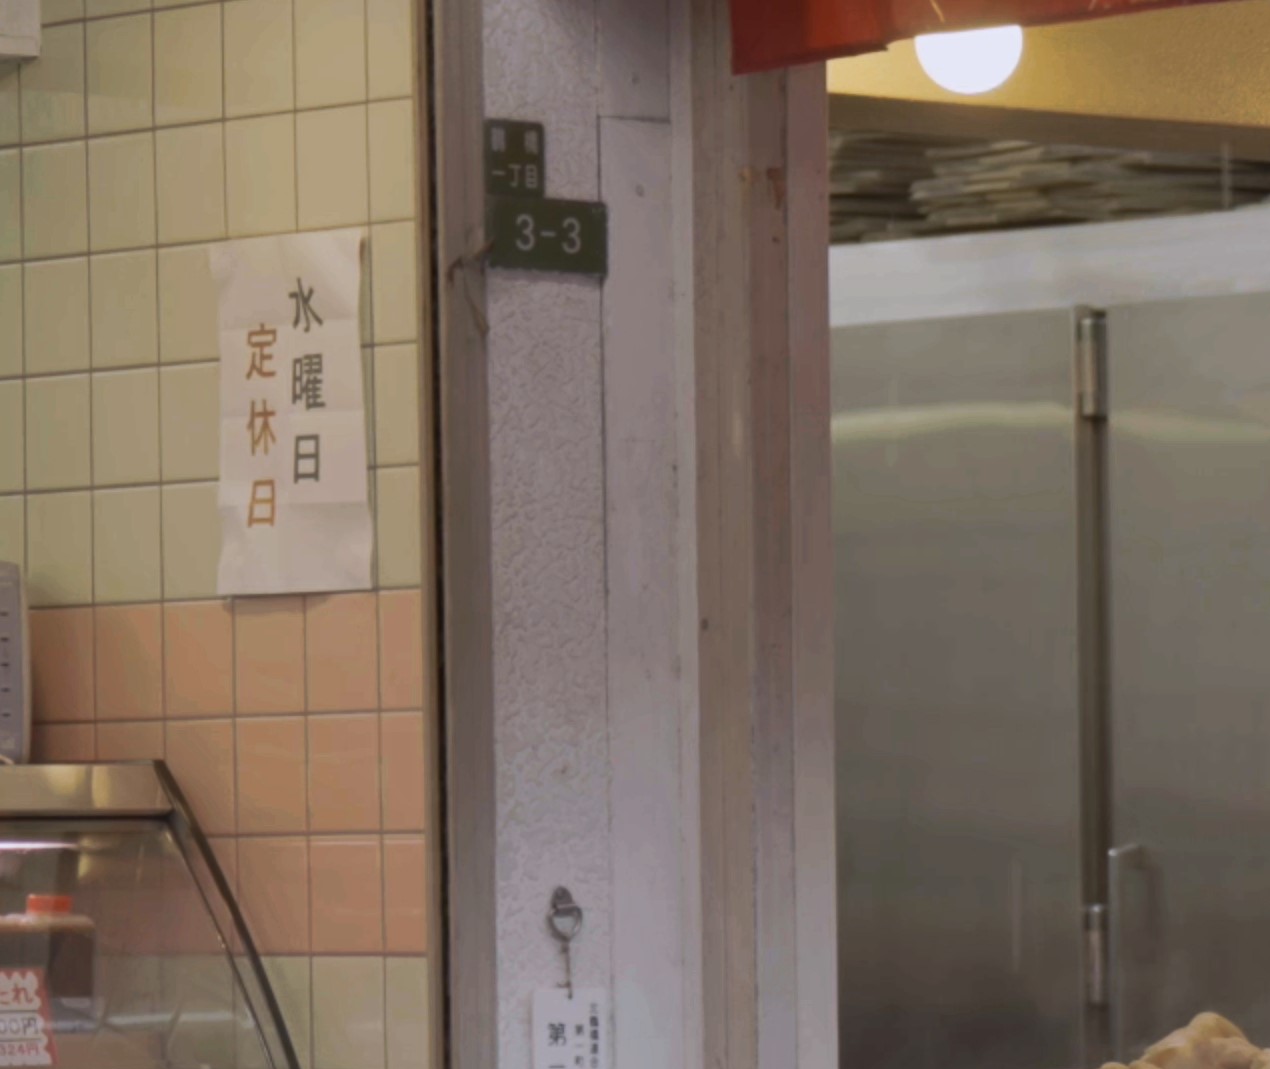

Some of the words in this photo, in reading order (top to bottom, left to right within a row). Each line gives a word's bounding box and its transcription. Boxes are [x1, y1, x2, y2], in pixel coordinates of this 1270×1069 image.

[492, 164, 537, 188] 一丁目
[515, 213, 581, 254] 3-3
[245, 324, 277, 528] 定休日
[288, 277, 326, 484] 水曜日
